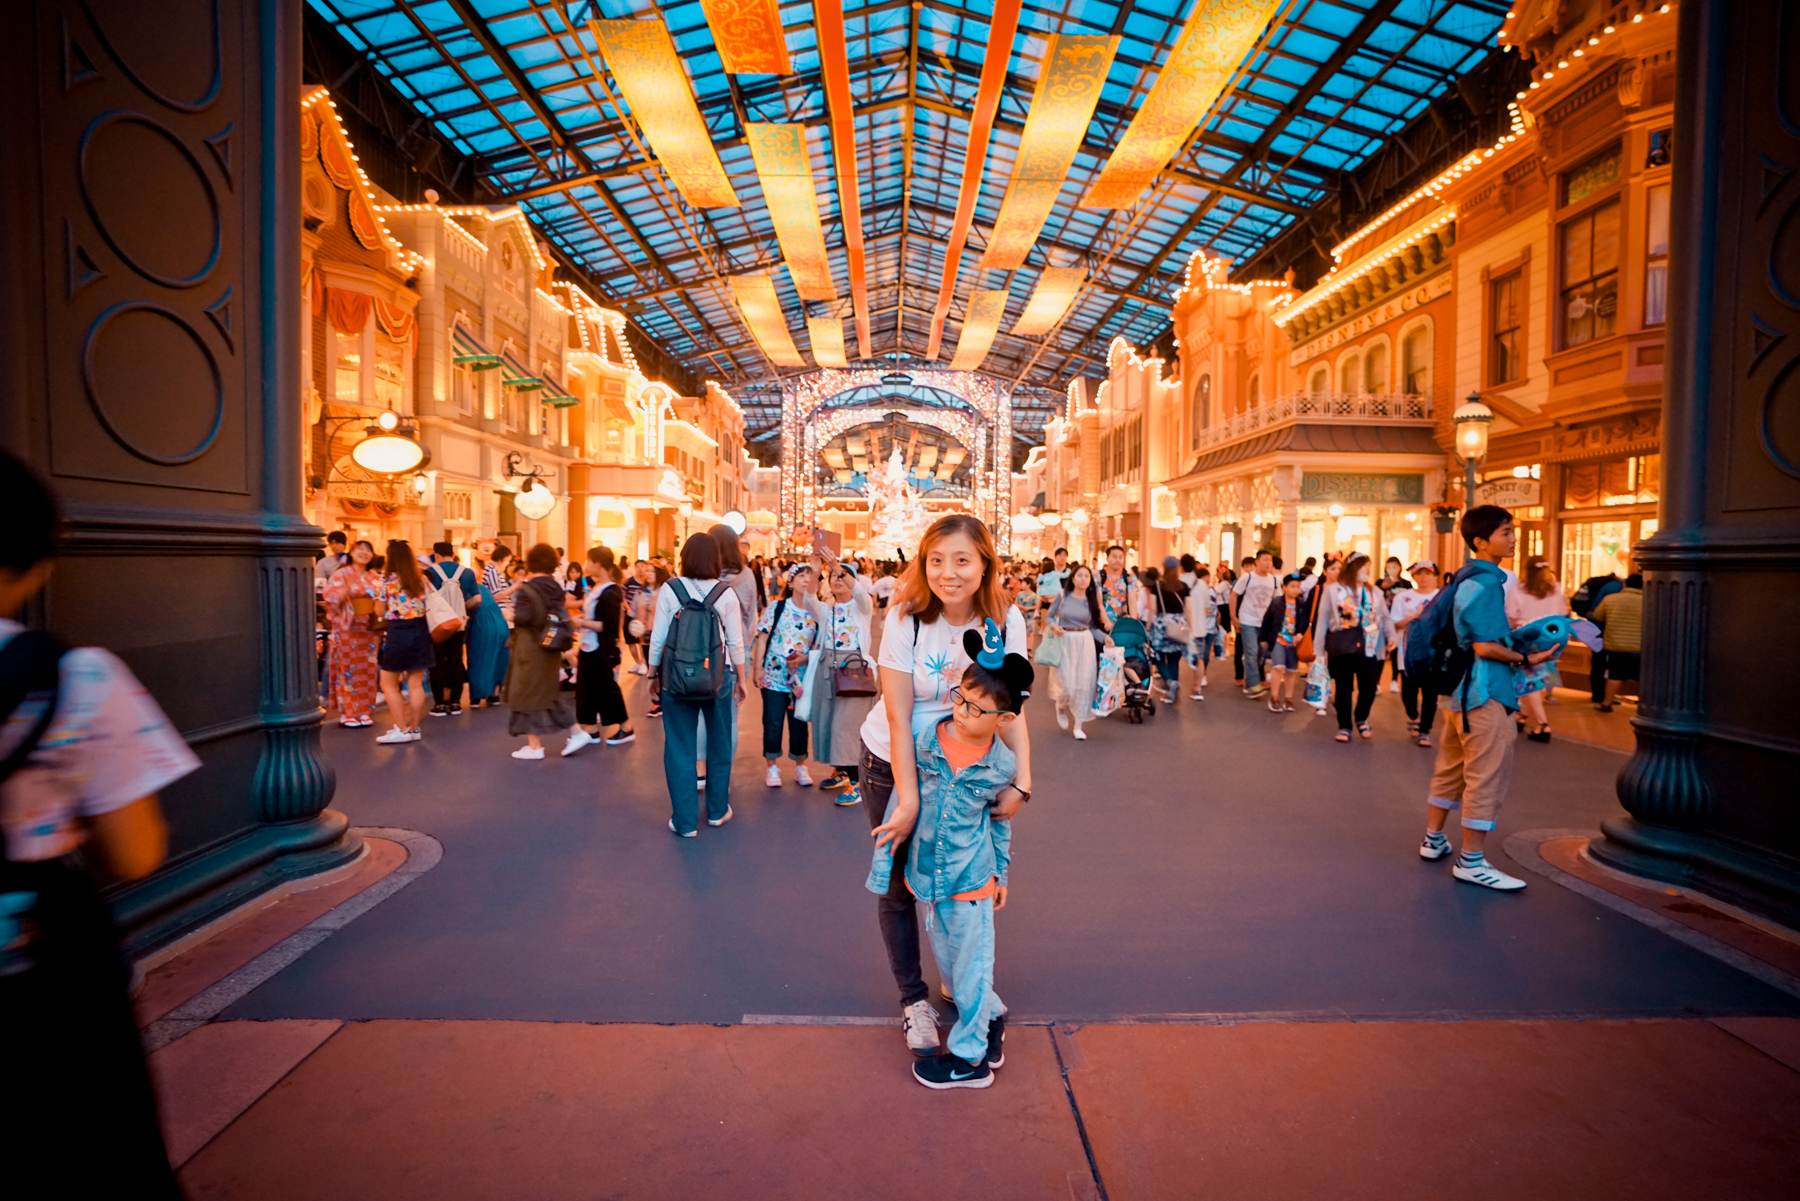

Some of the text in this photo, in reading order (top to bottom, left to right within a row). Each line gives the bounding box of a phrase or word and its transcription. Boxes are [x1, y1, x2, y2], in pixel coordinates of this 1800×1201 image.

[1306, 309, 1379, 359] DISNEY
[1384, 304, 1395, 320] &
[649, 393, 657, 458] ARCADE
[1305, 474, 1384, 497] DISNEY
[1341, 490, 1383, 501] GIFTS
